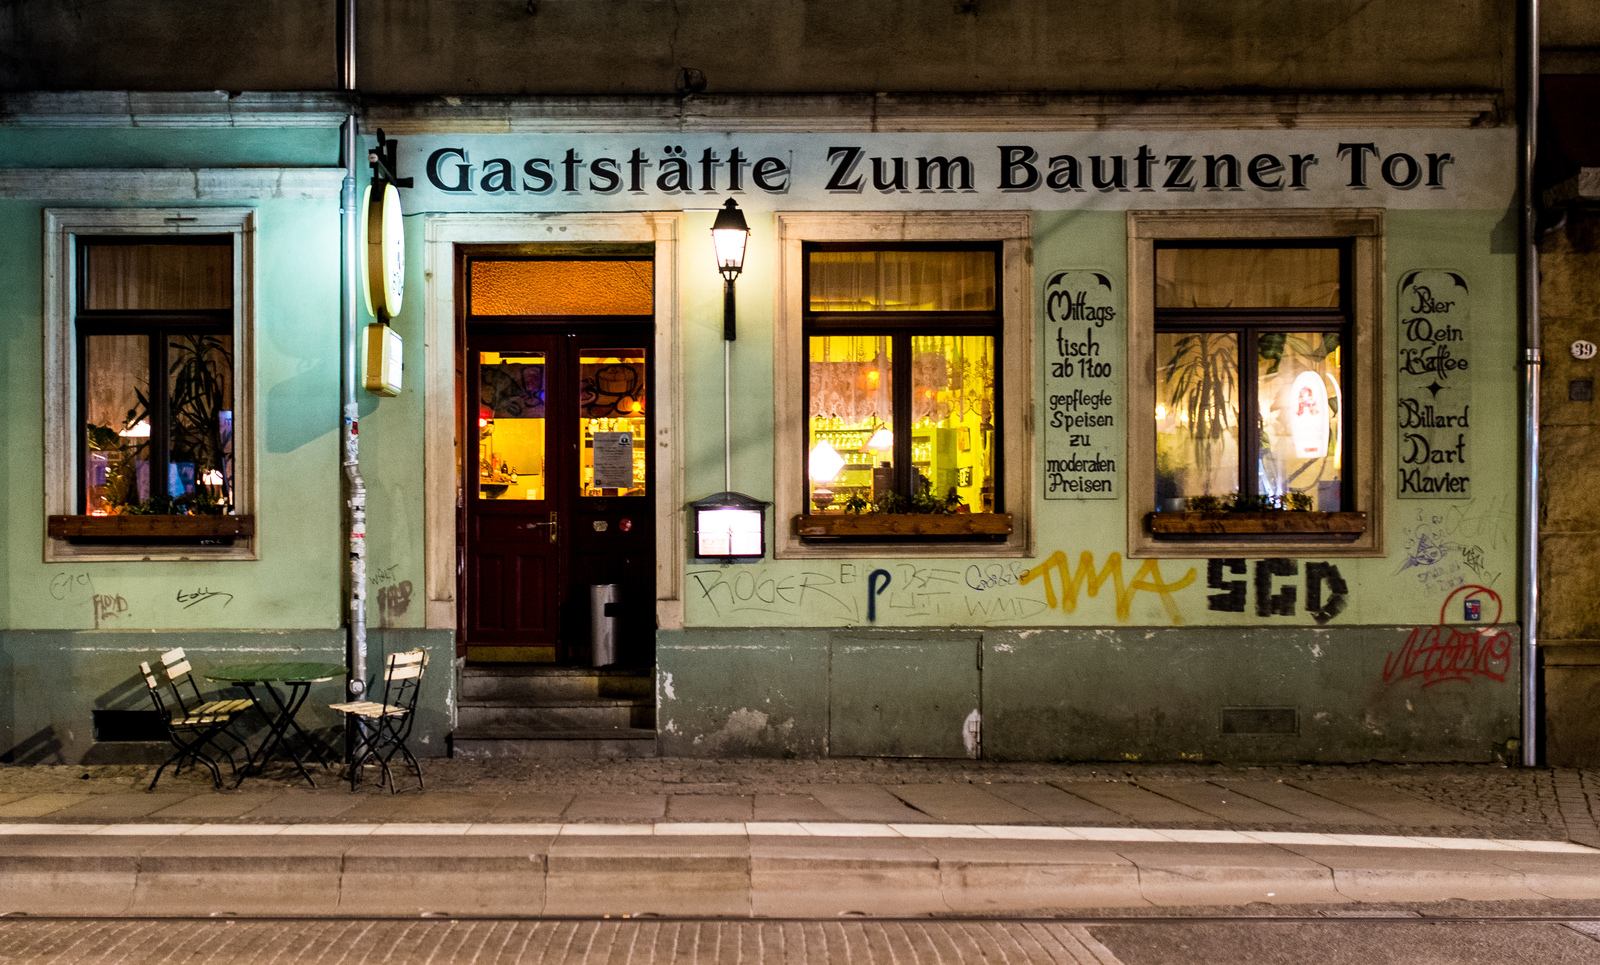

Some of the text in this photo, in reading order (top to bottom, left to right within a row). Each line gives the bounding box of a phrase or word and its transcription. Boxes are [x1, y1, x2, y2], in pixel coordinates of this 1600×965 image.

[425, 141, 1454, 195] Gaststätte Zum Bautzner Tor
[1411, 285, 1455, 314] Bier
[1056, 327, 1101, 357] tisch
[1402, 317, 1464, 345] Wein
[1400, 344, 1469, 380] Kaffee
[1575, 342, 1593, 357] 39
[1051, 357, 1074, 378] ab
[1050, 388, 1113, 412] gepflegte
[1399, 397, 1470, 428] Billard
[1050, 410, 1114, 432] Speisen
[1069, 433, 1092, 447] zu
[1402, 432, 1466, 465] Dart
[1047, 452, 1116, 473] moderaten
[1048, 472, 1113, 493] Preisen
[1400, 467, 1470, 493] Klavier
